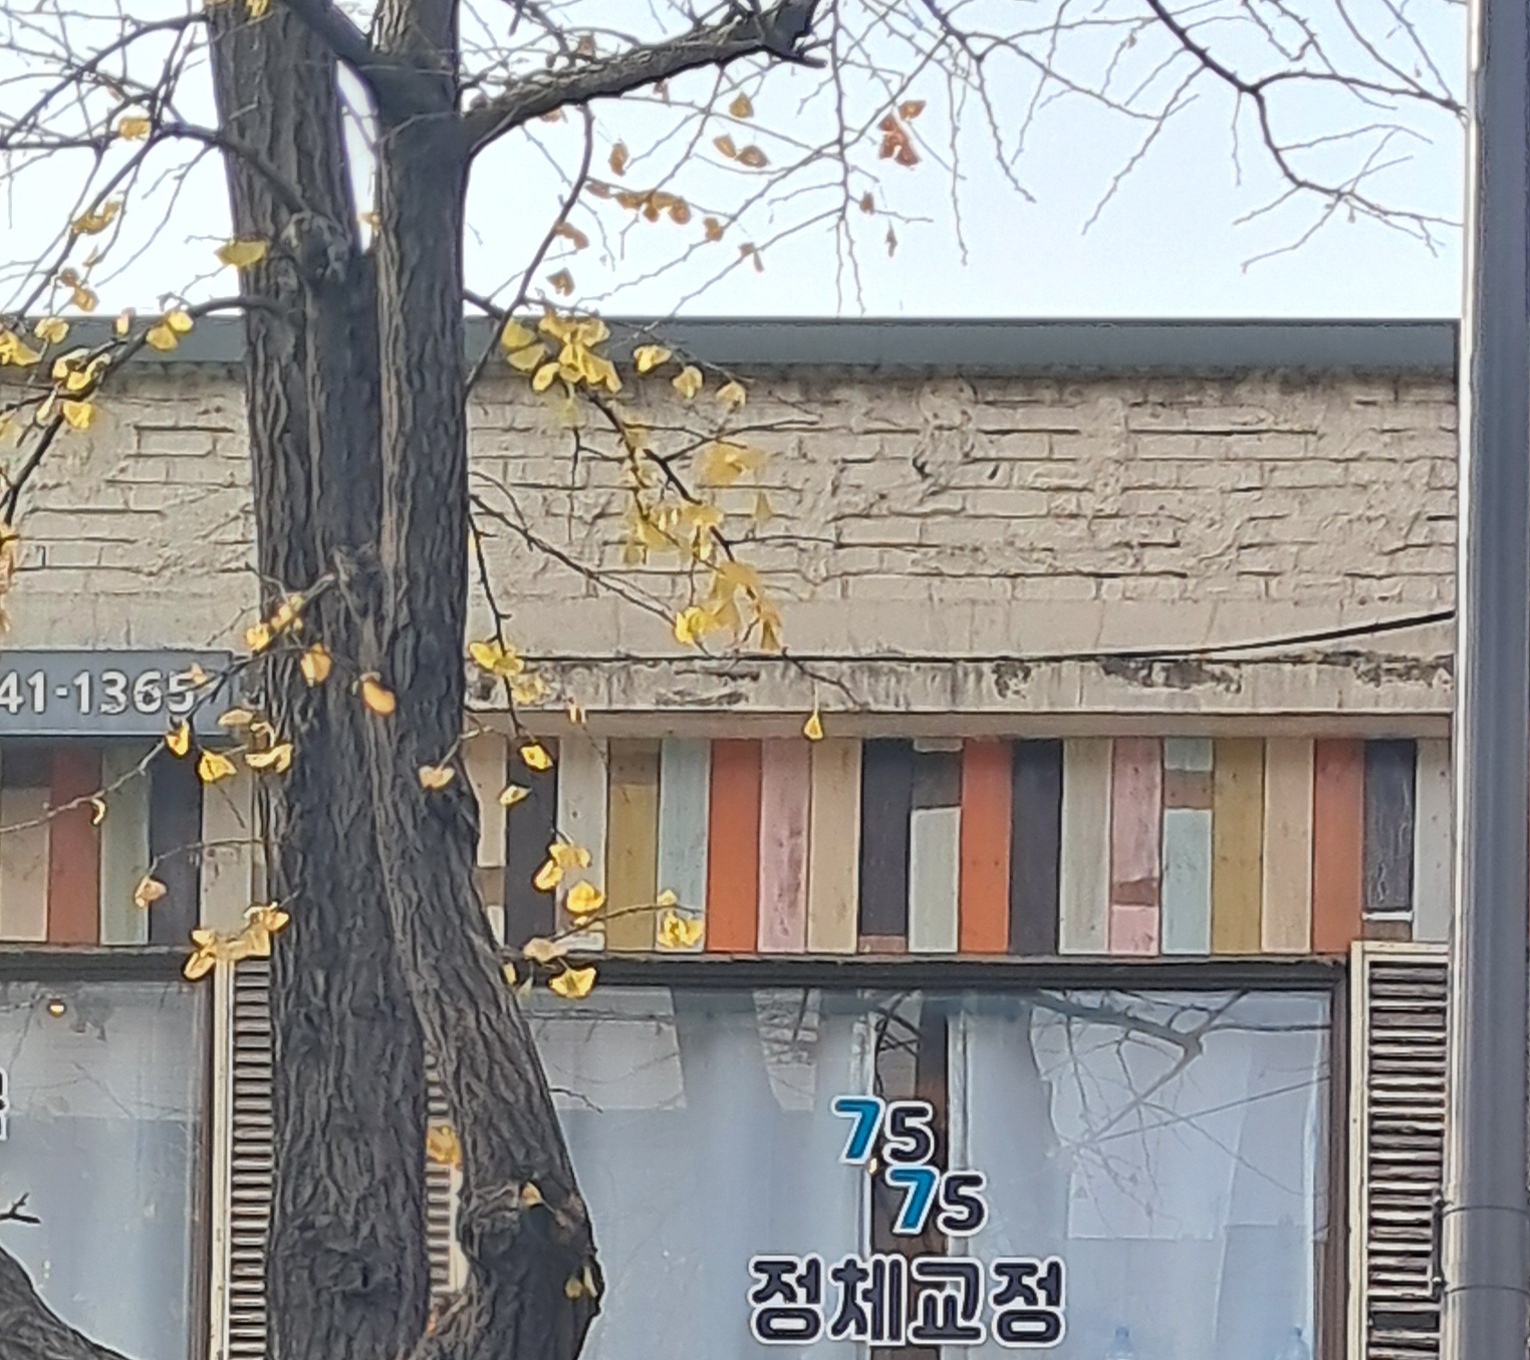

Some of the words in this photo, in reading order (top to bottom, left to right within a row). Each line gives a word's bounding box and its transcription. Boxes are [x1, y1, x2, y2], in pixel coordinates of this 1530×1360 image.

[831, 1094, 935, 1165] 75
[885, 1165, 988, 1235] 75
[747, 1252, 1067, 1348] 정체교정
